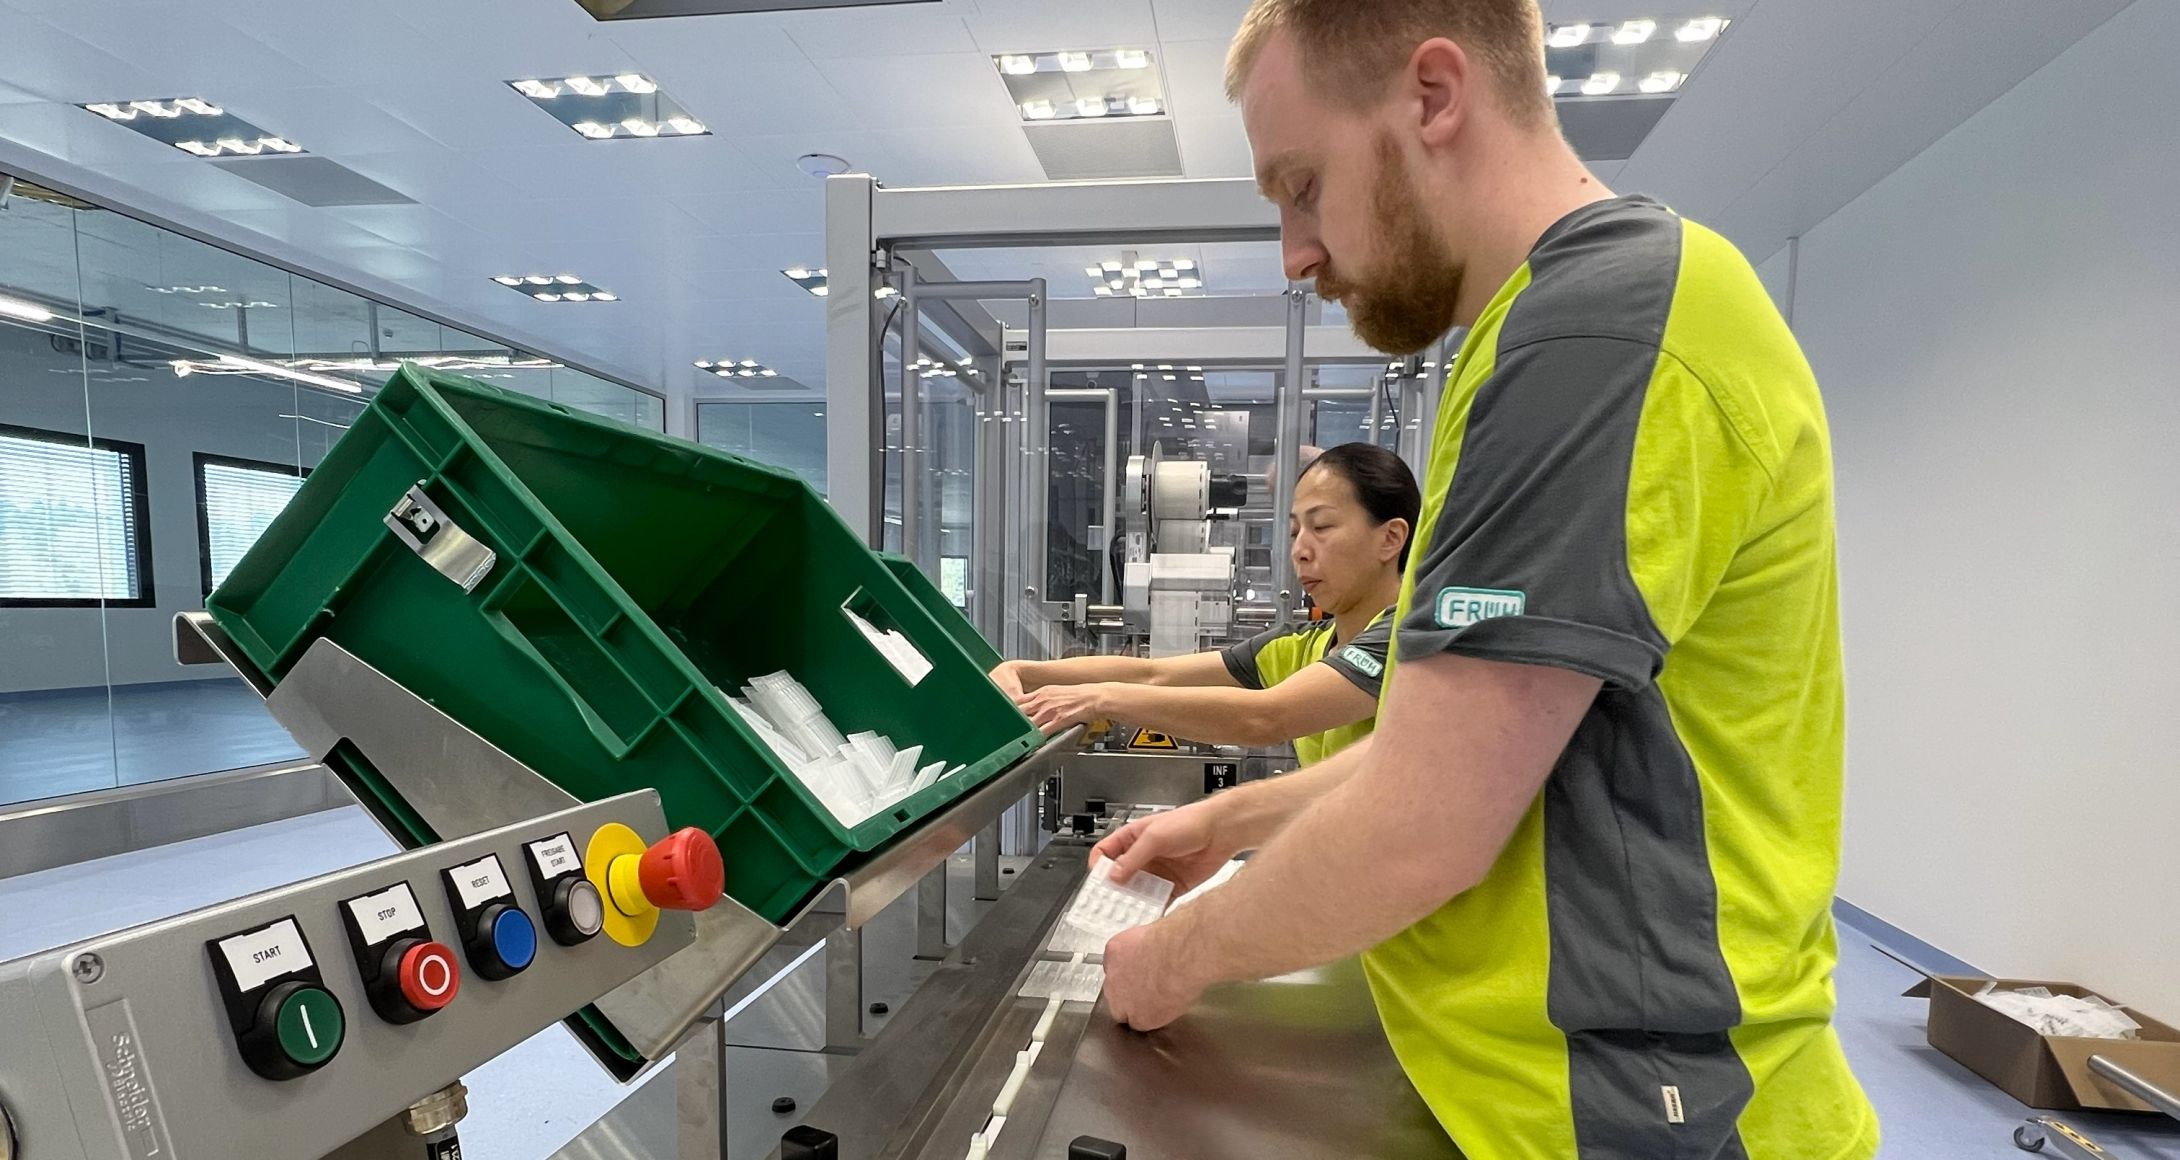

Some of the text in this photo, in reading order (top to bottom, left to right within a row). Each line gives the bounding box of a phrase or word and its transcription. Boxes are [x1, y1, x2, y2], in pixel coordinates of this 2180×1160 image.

[1212, 765, 1228, 776] INF
[1218, 777, 1224, 788] 3
[471, 875, 490, 888] RESET
[377, 907, 397, 921] STOP
[252, 945, 281, 964] START
[112, 1032, 151, 1128] Schneider
